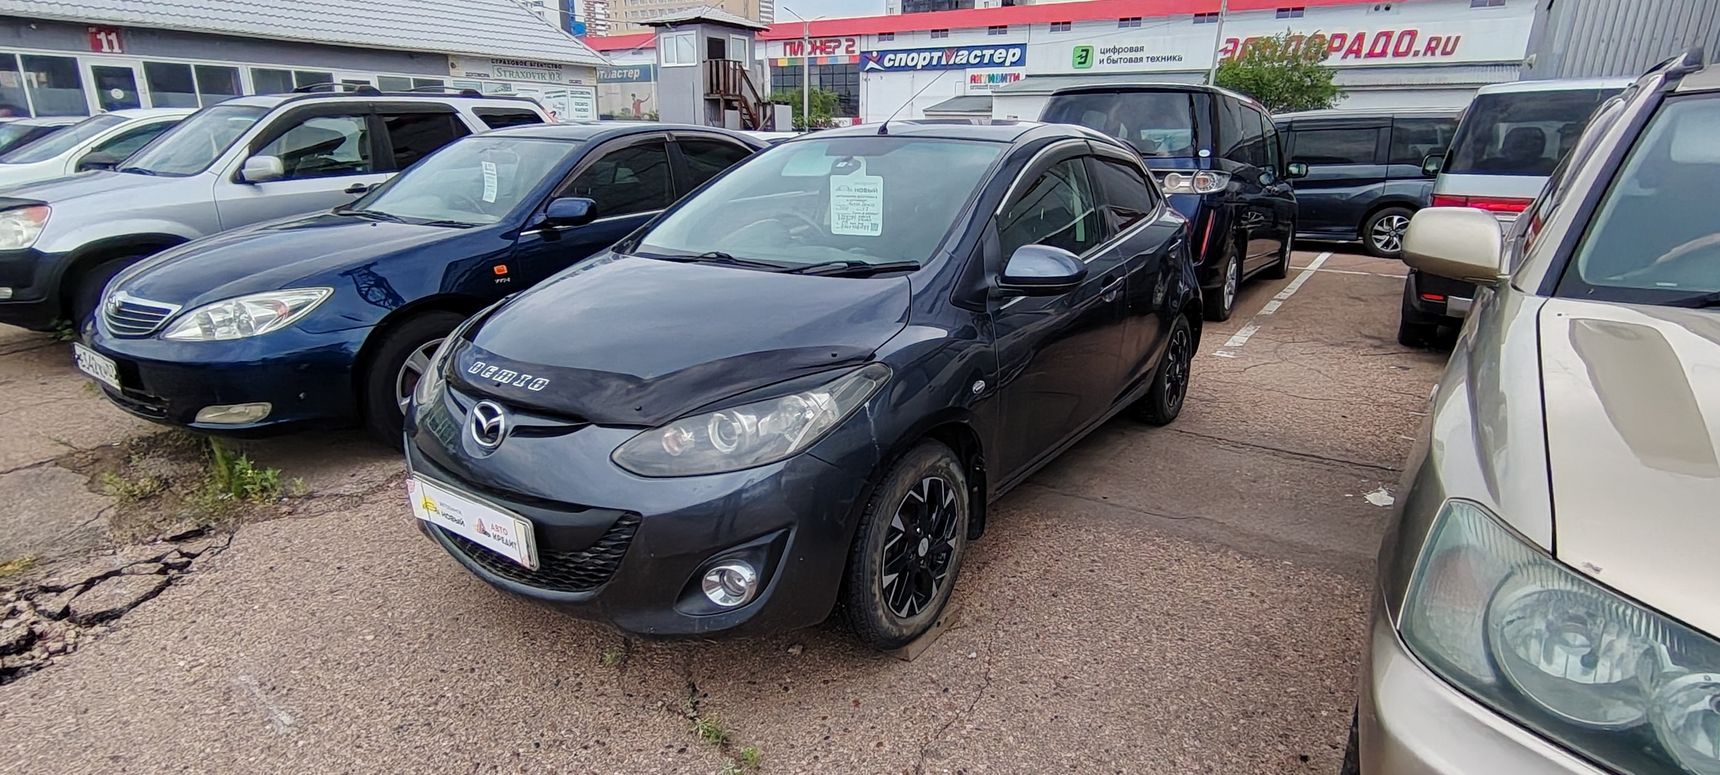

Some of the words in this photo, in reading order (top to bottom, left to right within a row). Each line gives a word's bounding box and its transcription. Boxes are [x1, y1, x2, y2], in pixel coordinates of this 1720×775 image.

[96, 31, 122, 53] 11
[845, 38, 856, 54] 2
[1099, 45, 1145, 55] цифровая
[1106, 55, 1144, 65] бытовая
[1146, 54, 1183, 63] техника
[490, 522, 508, 536] АВТО
[492, 530, 517, 550] КРЕДИТ
